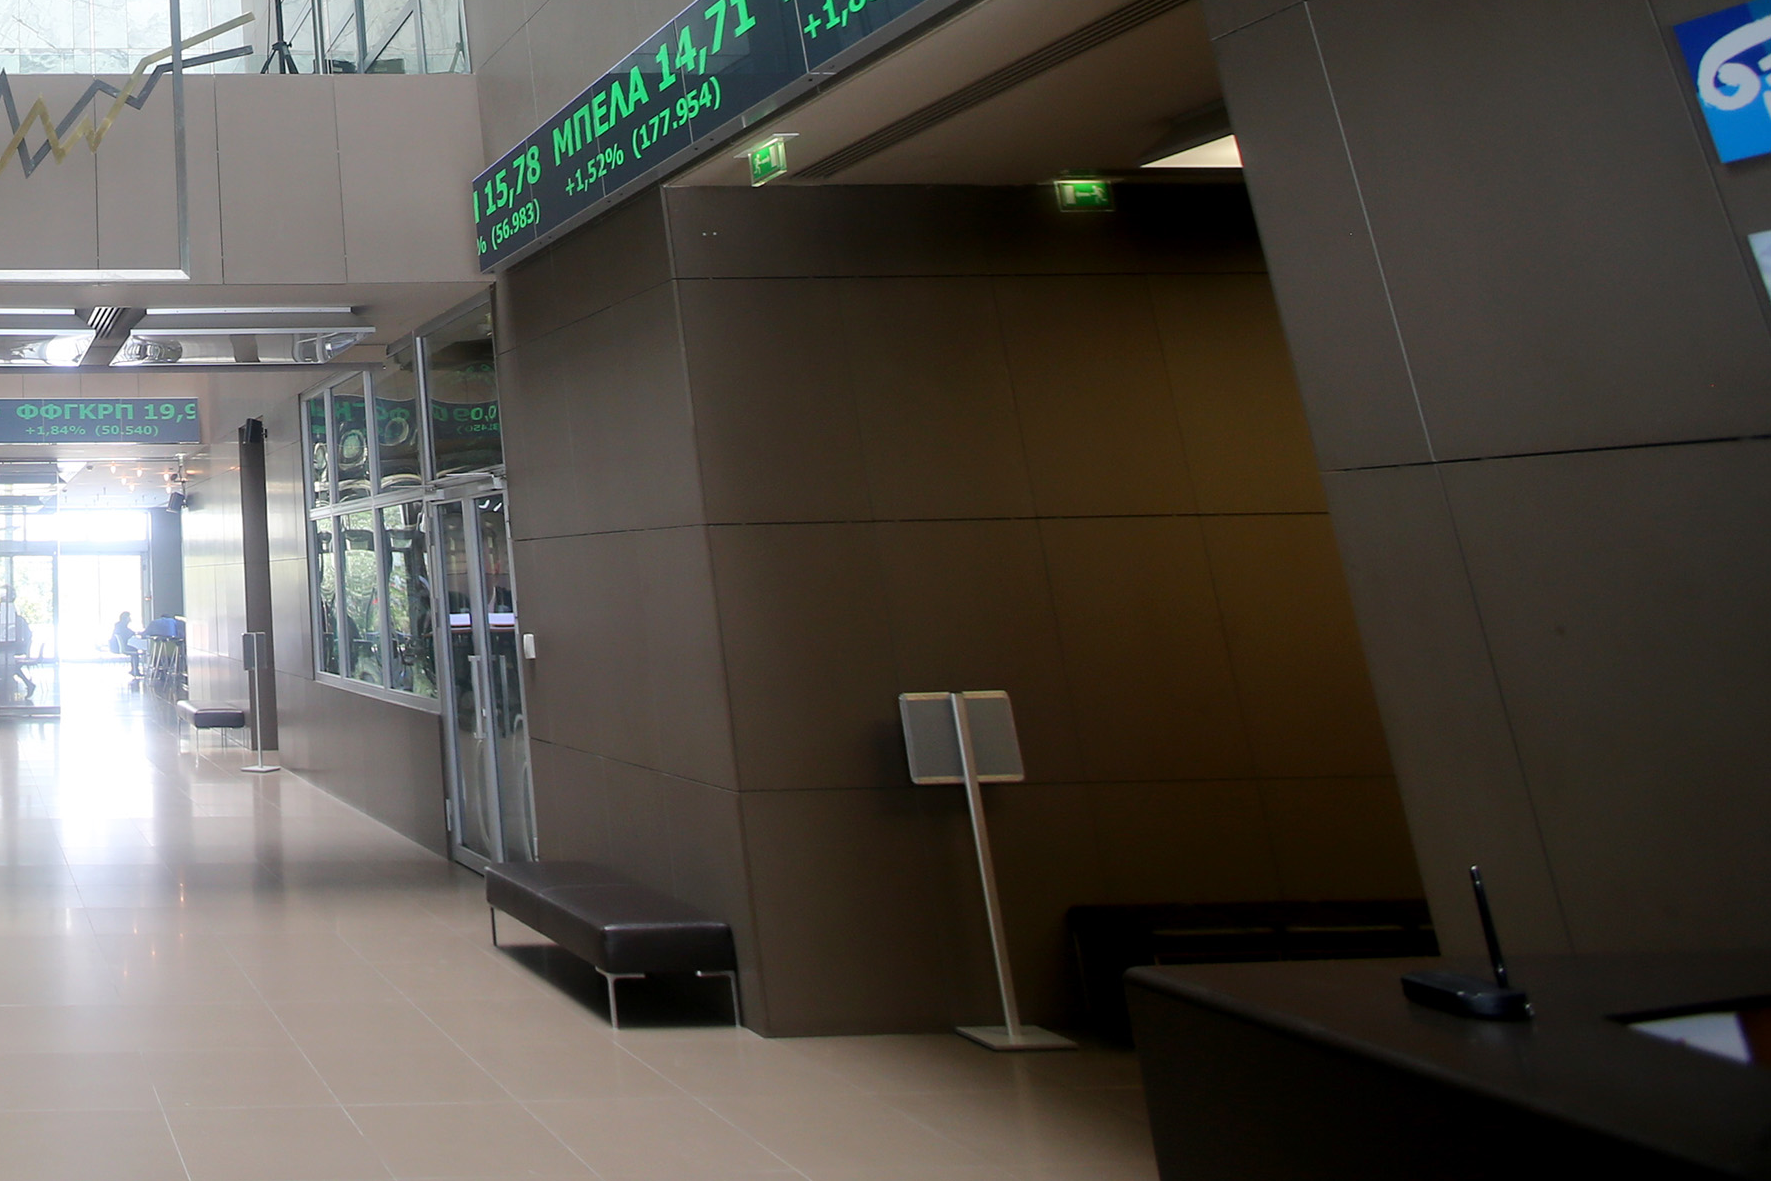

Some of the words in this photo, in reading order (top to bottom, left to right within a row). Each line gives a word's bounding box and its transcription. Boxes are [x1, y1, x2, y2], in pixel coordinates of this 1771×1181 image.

[484, 145, 542, 217] 15,78
[552, 65, 650, 167] ΜΠΕΛΑ
[491, 198, 541, 251] (56.983)
[565, 143, 625, 195] +1,52%
[631, 76, 722, 160] (177.954)
[16, 403, 134, 420] ΦΦΓΚΡΠ
[26, 425, 86, 436] +1,84%
[94, 425, 159, 437] (50.540)
